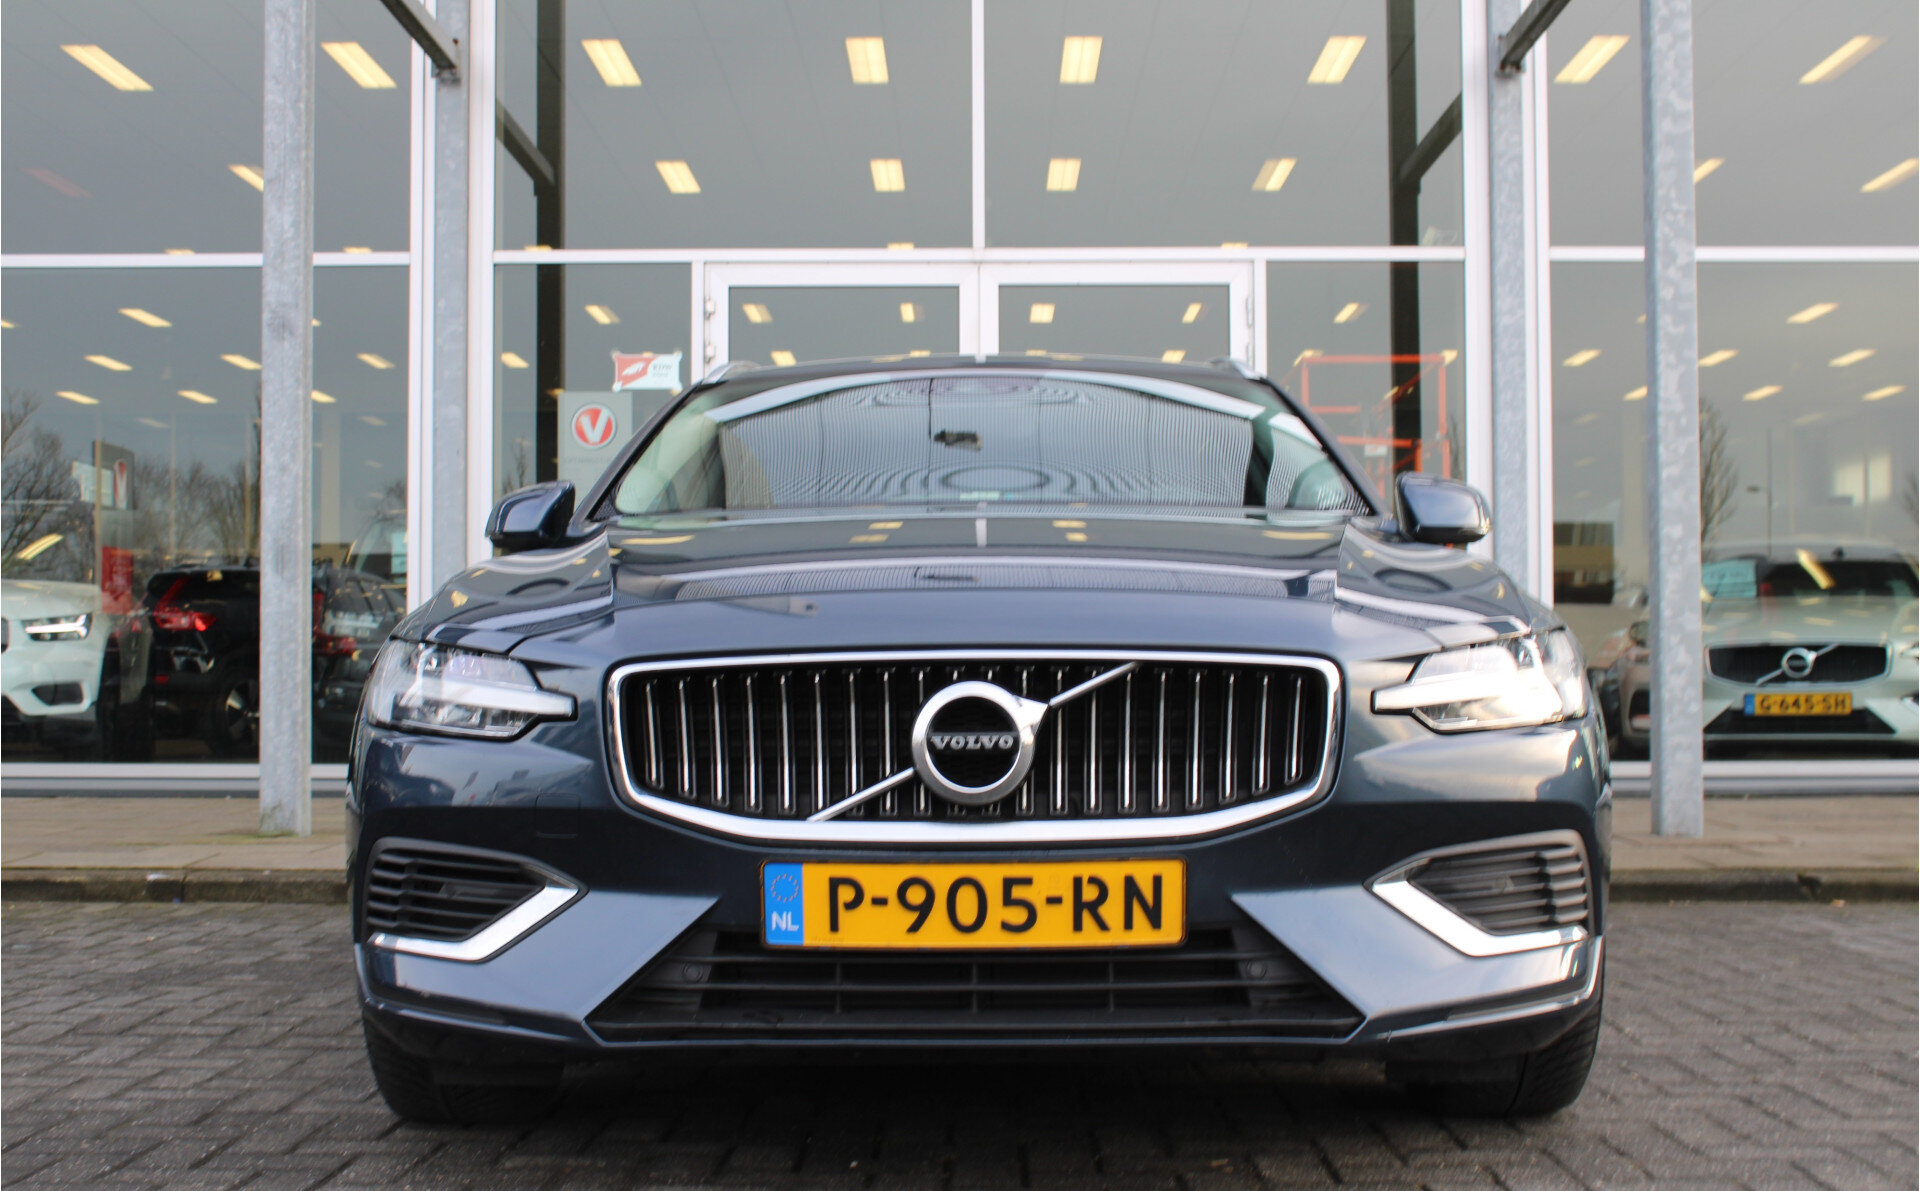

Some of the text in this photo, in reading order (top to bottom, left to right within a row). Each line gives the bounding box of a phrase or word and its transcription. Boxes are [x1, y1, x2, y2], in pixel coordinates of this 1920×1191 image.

[930, 735, 1014, 750] VOLVO
[828, 874, 1163, 934] P-905-RN
[771, 911, 800, 932] NL
